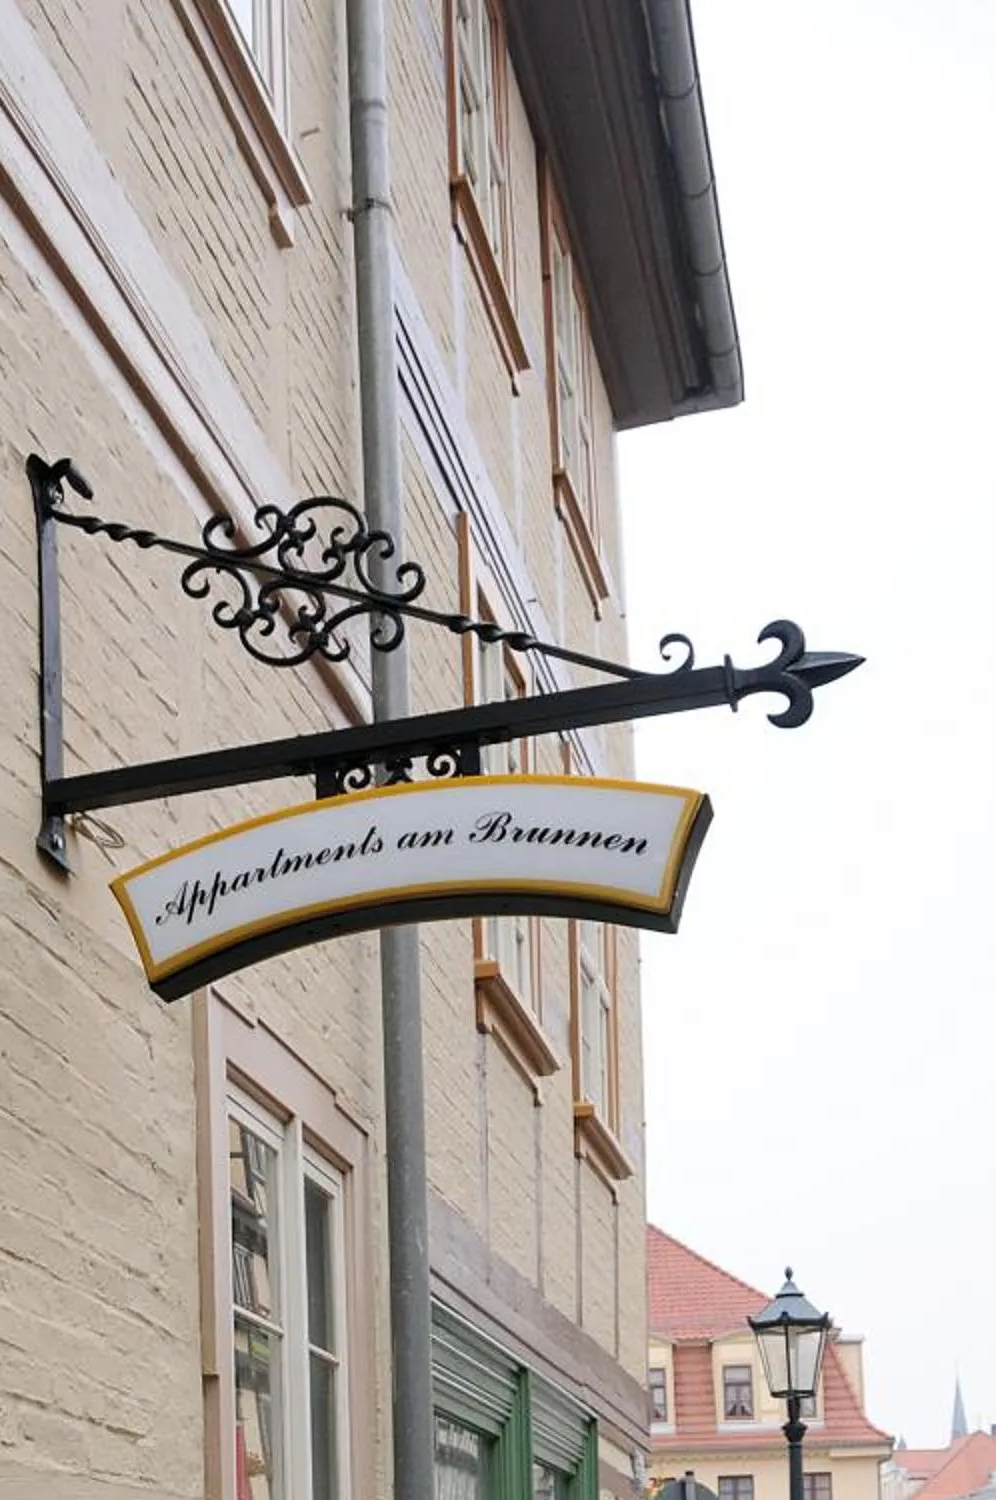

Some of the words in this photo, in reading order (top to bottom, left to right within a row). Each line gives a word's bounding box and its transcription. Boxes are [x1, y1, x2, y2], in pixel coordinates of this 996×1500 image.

[155, 825, 383, 925] Appartments
[397, 818, 454, 850] am
[469, 811, 647, 855] Brunnen
